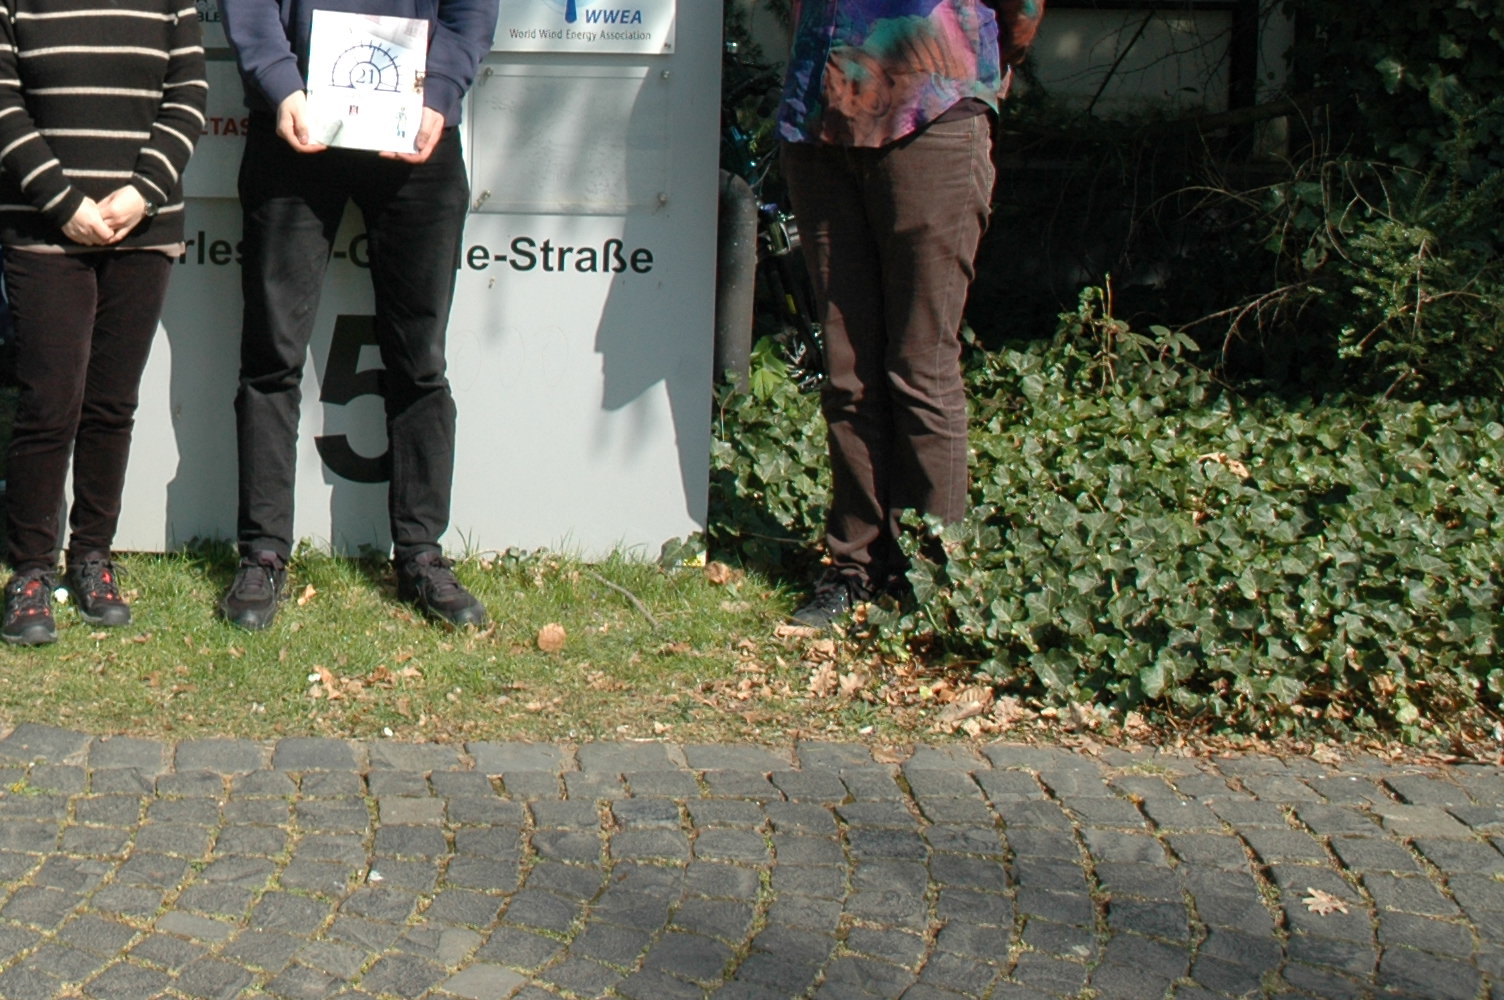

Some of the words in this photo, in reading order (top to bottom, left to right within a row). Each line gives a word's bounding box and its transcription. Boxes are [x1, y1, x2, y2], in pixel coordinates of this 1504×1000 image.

[585, 9, 642, 24] WWEA
[509, 28, 536, 39] World
[538, 29, 563, 39] Wind
[566, 30, 597, 42] Energy
[599, 30, 651, 40] Association
[355, 69, 374, 85] 21
[313, 314, 390, 484] 5
